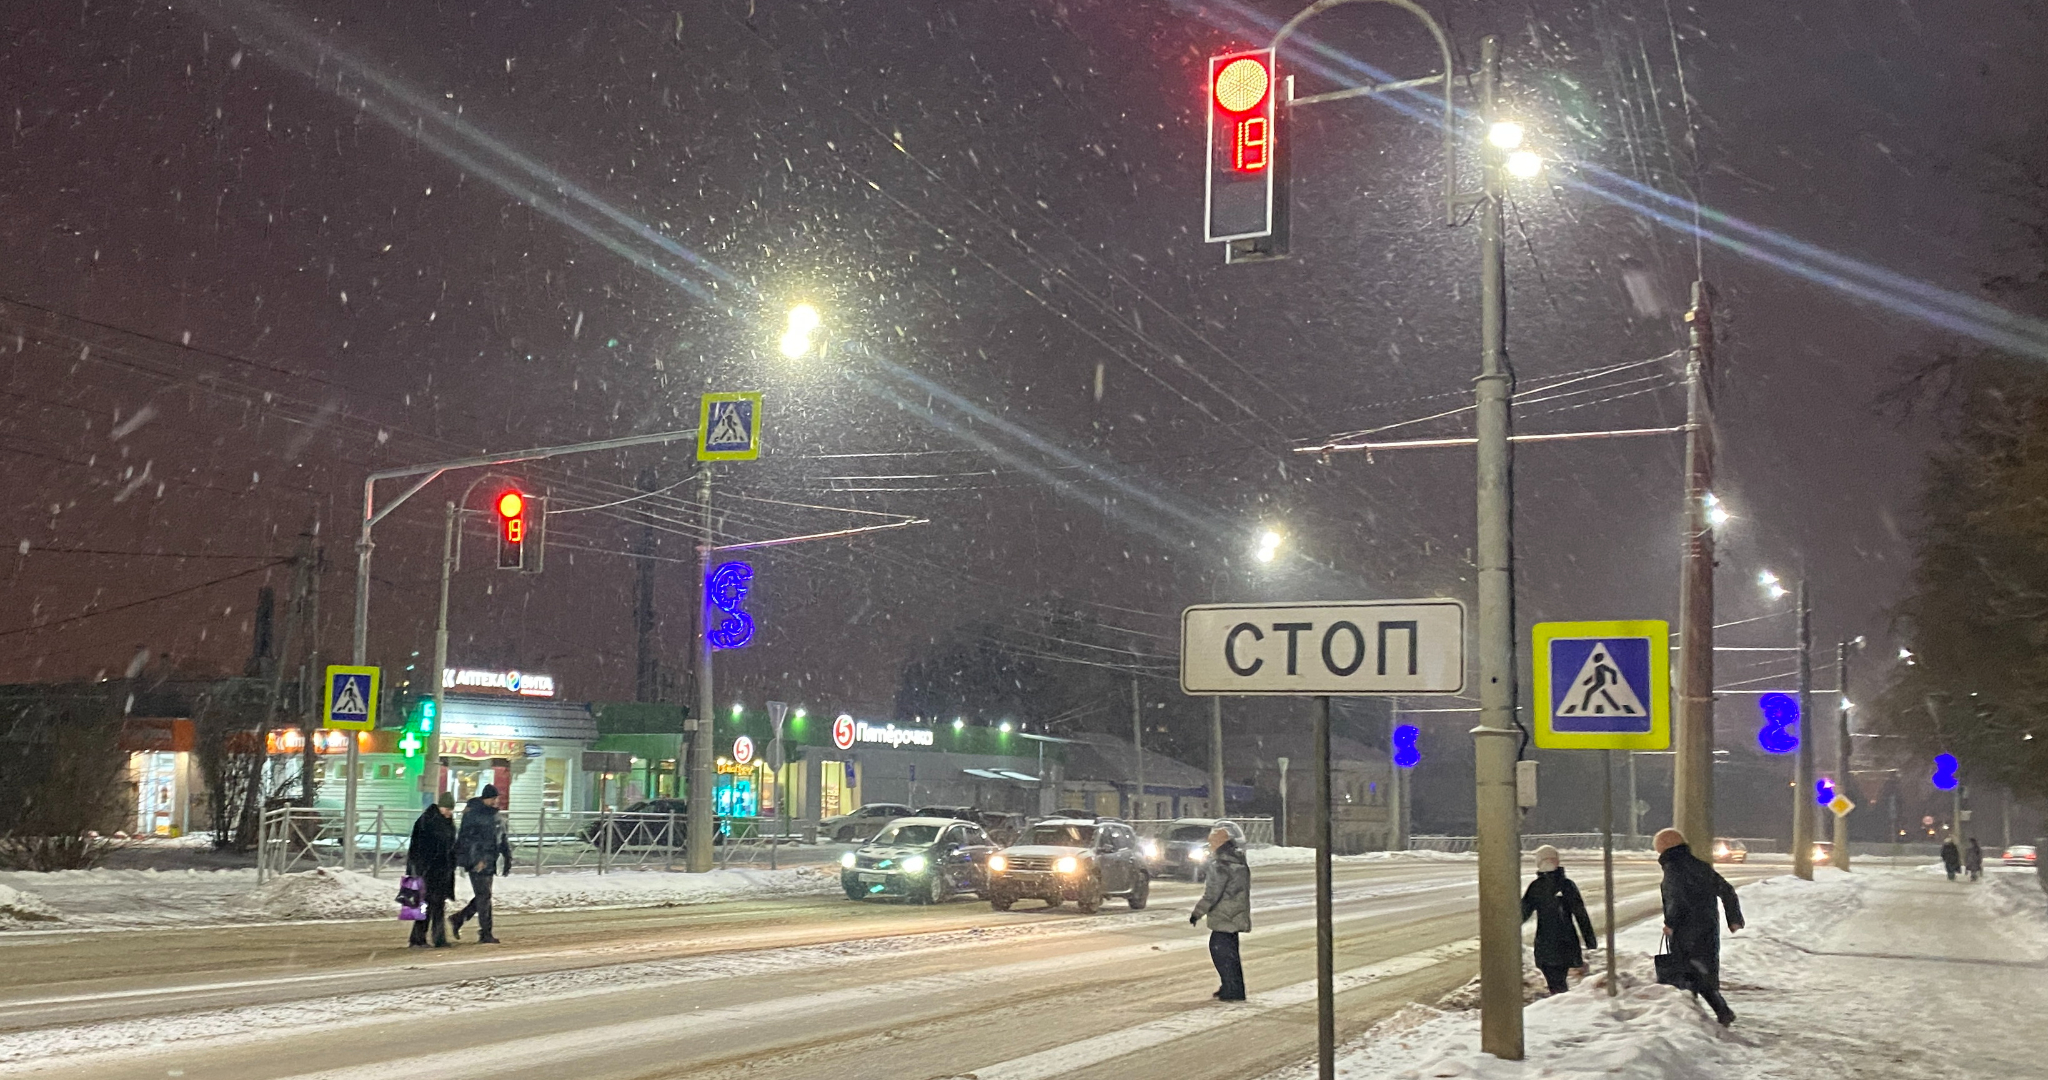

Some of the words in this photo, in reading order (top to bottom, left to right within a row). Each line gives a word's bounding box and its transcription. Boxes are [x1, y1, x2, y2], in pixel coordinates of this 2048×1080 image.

[1236, 117, 1268, 170] 19
[508, 519, 521, 542] 19
[1224, 620, 1418, 677] СТОП
[455, 670, 508, 688] АПТЕКА
[856, 722, 934, 749] Пятёрочка
